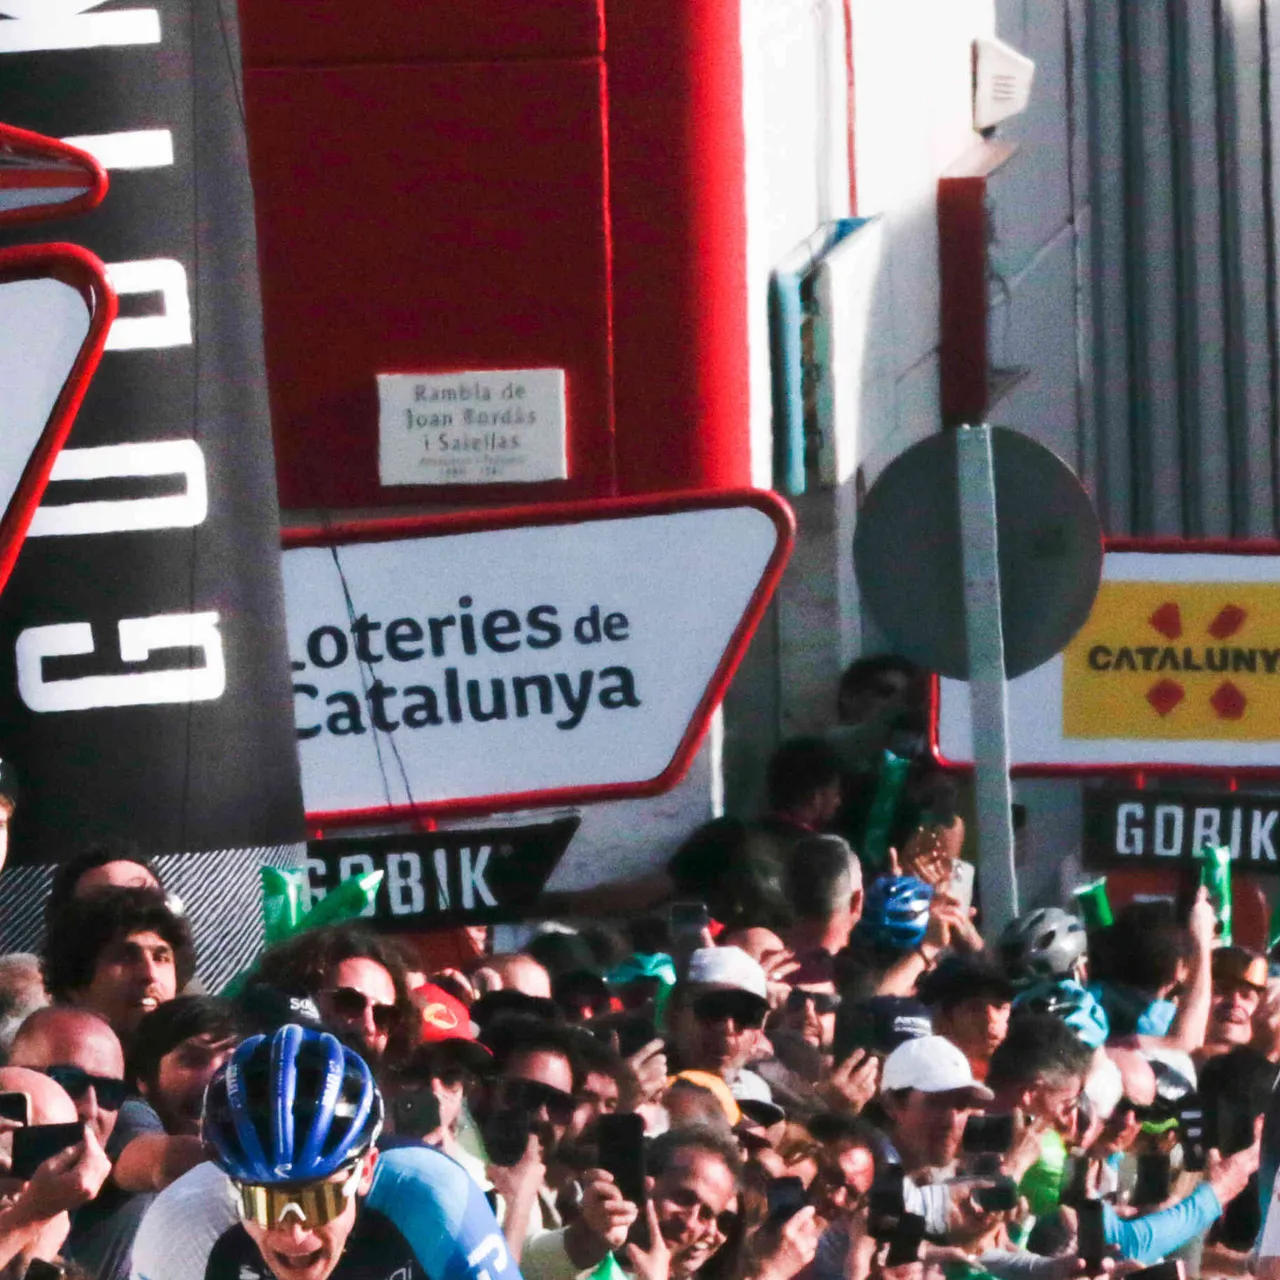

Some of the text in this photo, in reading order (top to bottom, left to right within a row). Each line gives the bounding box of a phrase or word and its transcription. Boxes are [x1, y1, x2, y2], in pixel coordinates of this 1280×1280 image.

[406, 407, 453, 429] Joan
[414, 382, 526, 401] Rambla de
[291, 595, 630, 671] oteries de
[293, 664, 641, 740] Catalunya
[1116, 803, 1280, 861] GOBIK
